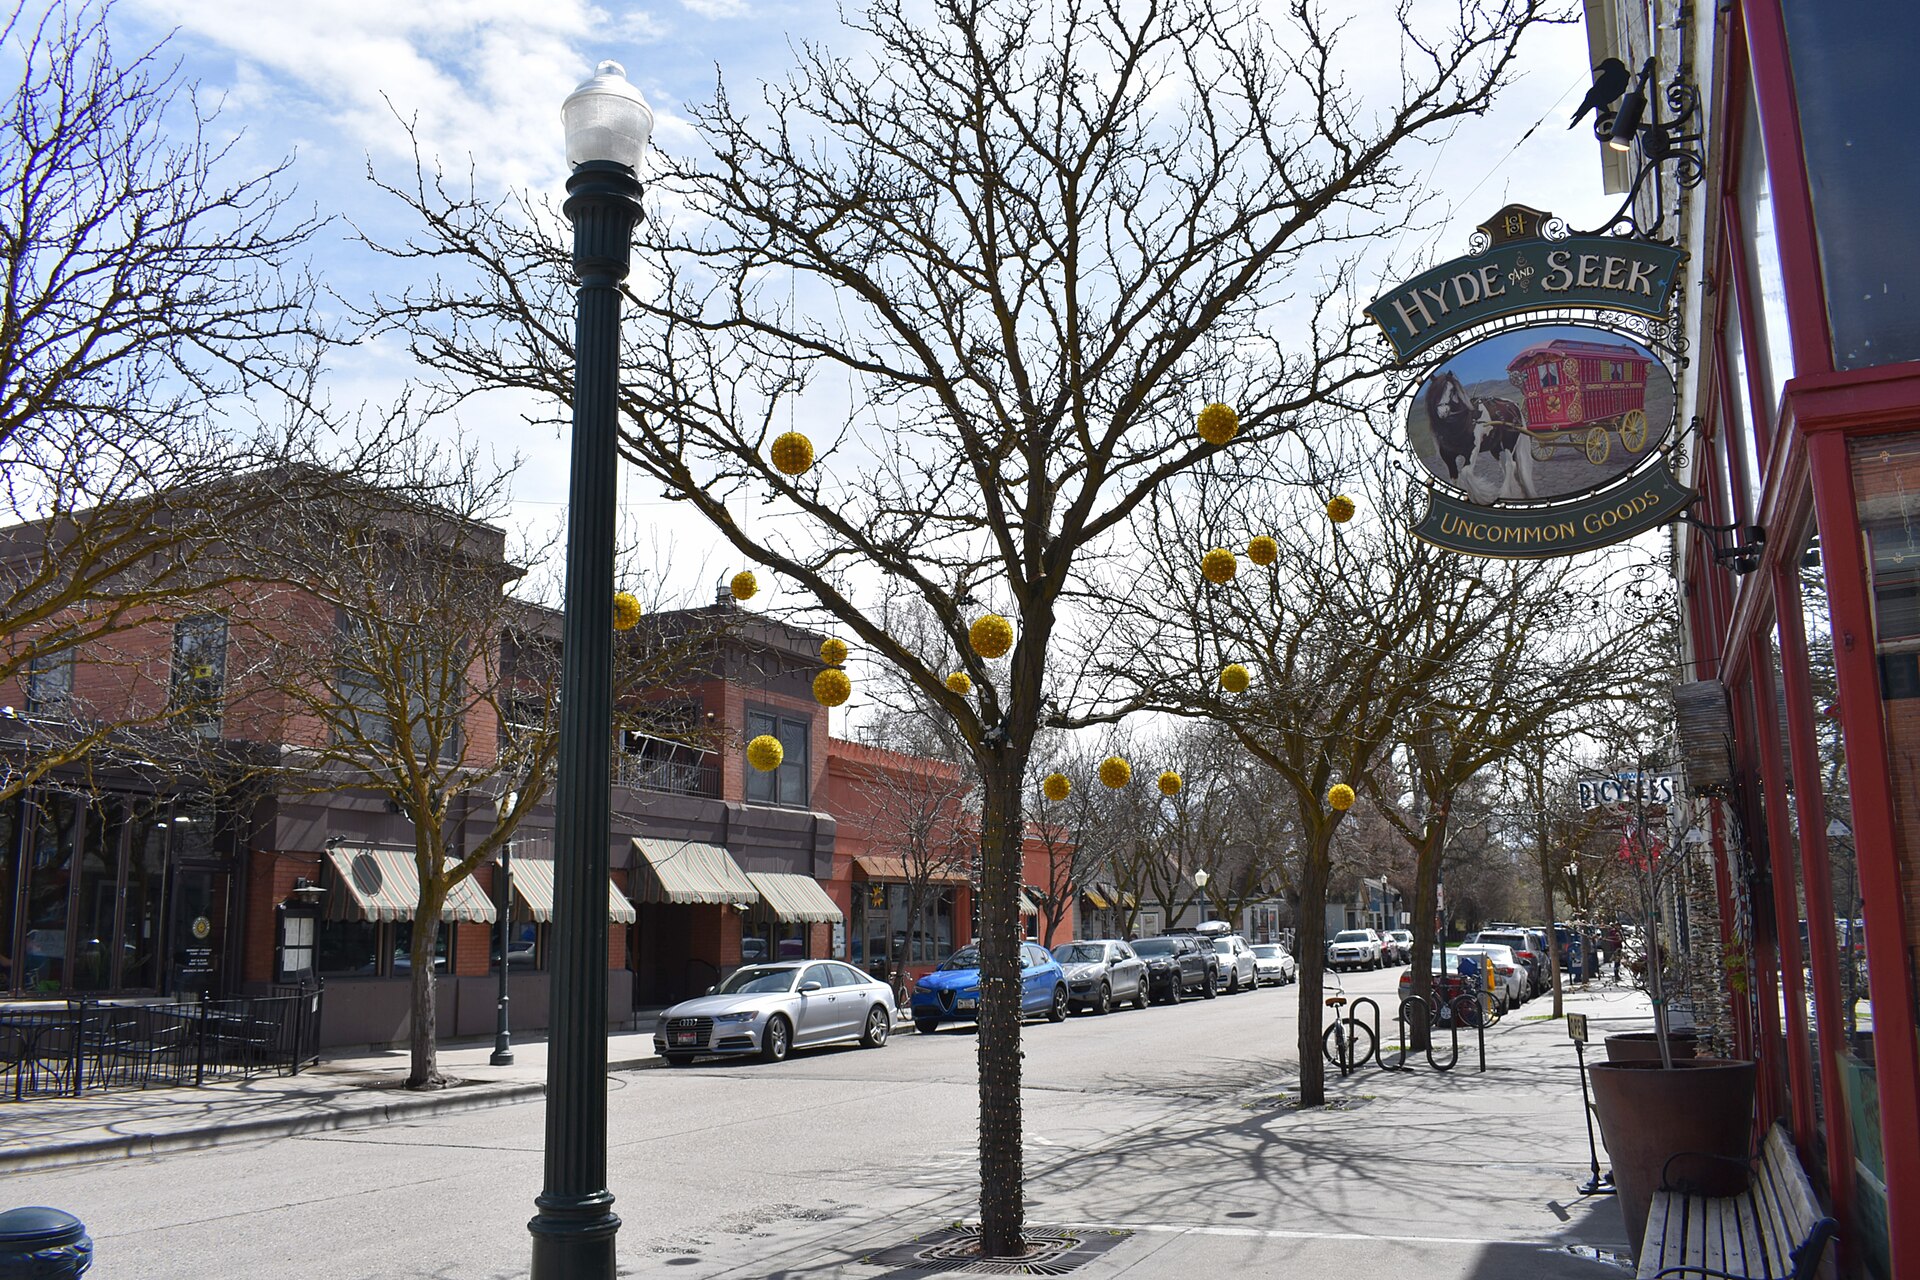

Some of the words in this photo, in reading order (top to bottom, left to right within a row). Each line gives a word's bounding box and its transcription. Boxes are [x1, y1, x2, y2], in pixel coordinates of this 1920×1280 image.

[1391, 263, 1506, 338] HYDE
[1508, 266, 1535, 286] AND
[1541, 250, 1660, 297] SEEK
[1440, 512, 1576, 544] UNCOMMON
[1582, 489, 1661, 535] GOODS
[1579, 777, 1672, 809] BICYES
